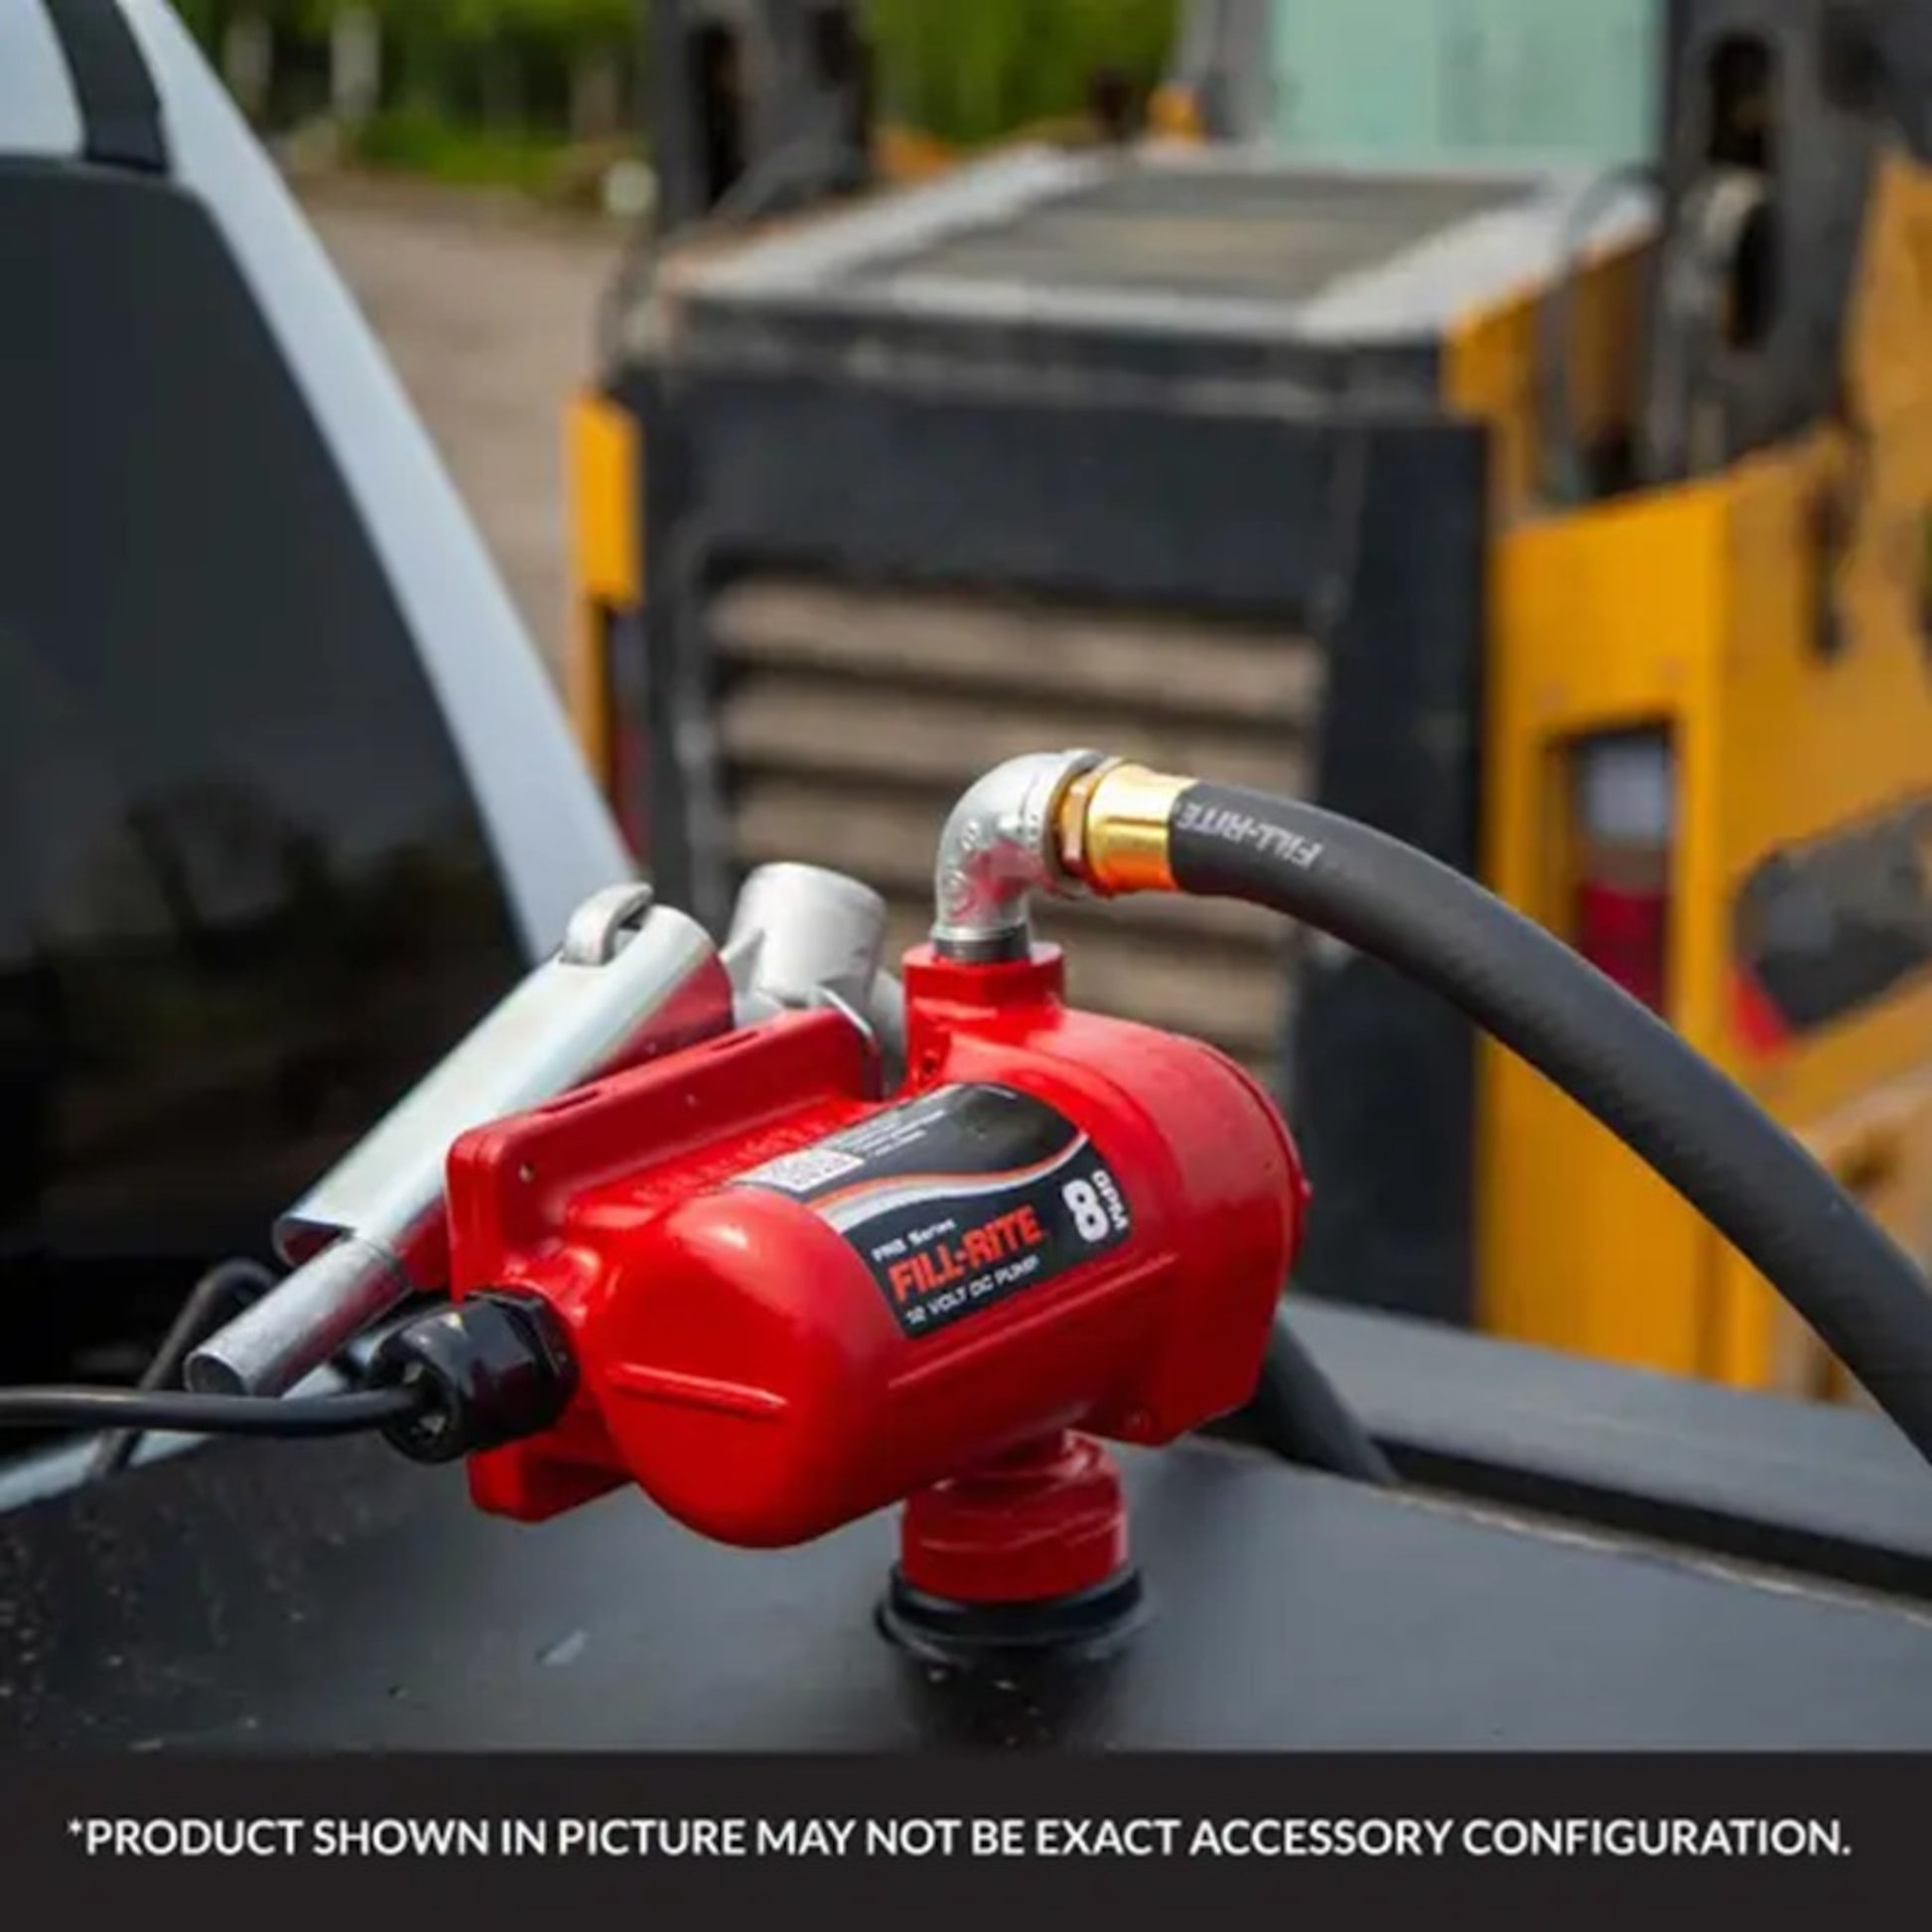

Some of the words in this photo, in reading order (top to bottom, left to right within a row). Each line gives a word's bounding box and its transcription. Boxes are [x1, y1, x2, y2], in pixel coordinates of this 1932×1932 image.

[1176, 802, 1324, 870] FILL-RITE
[1062, 1178, 1109, 1242] 8
[888, 1203, 1042, 1304] FILL-RITE
[926, 1286, 969, 1314] VOLT
[993, 1254, 1039, 1287] PUMP
